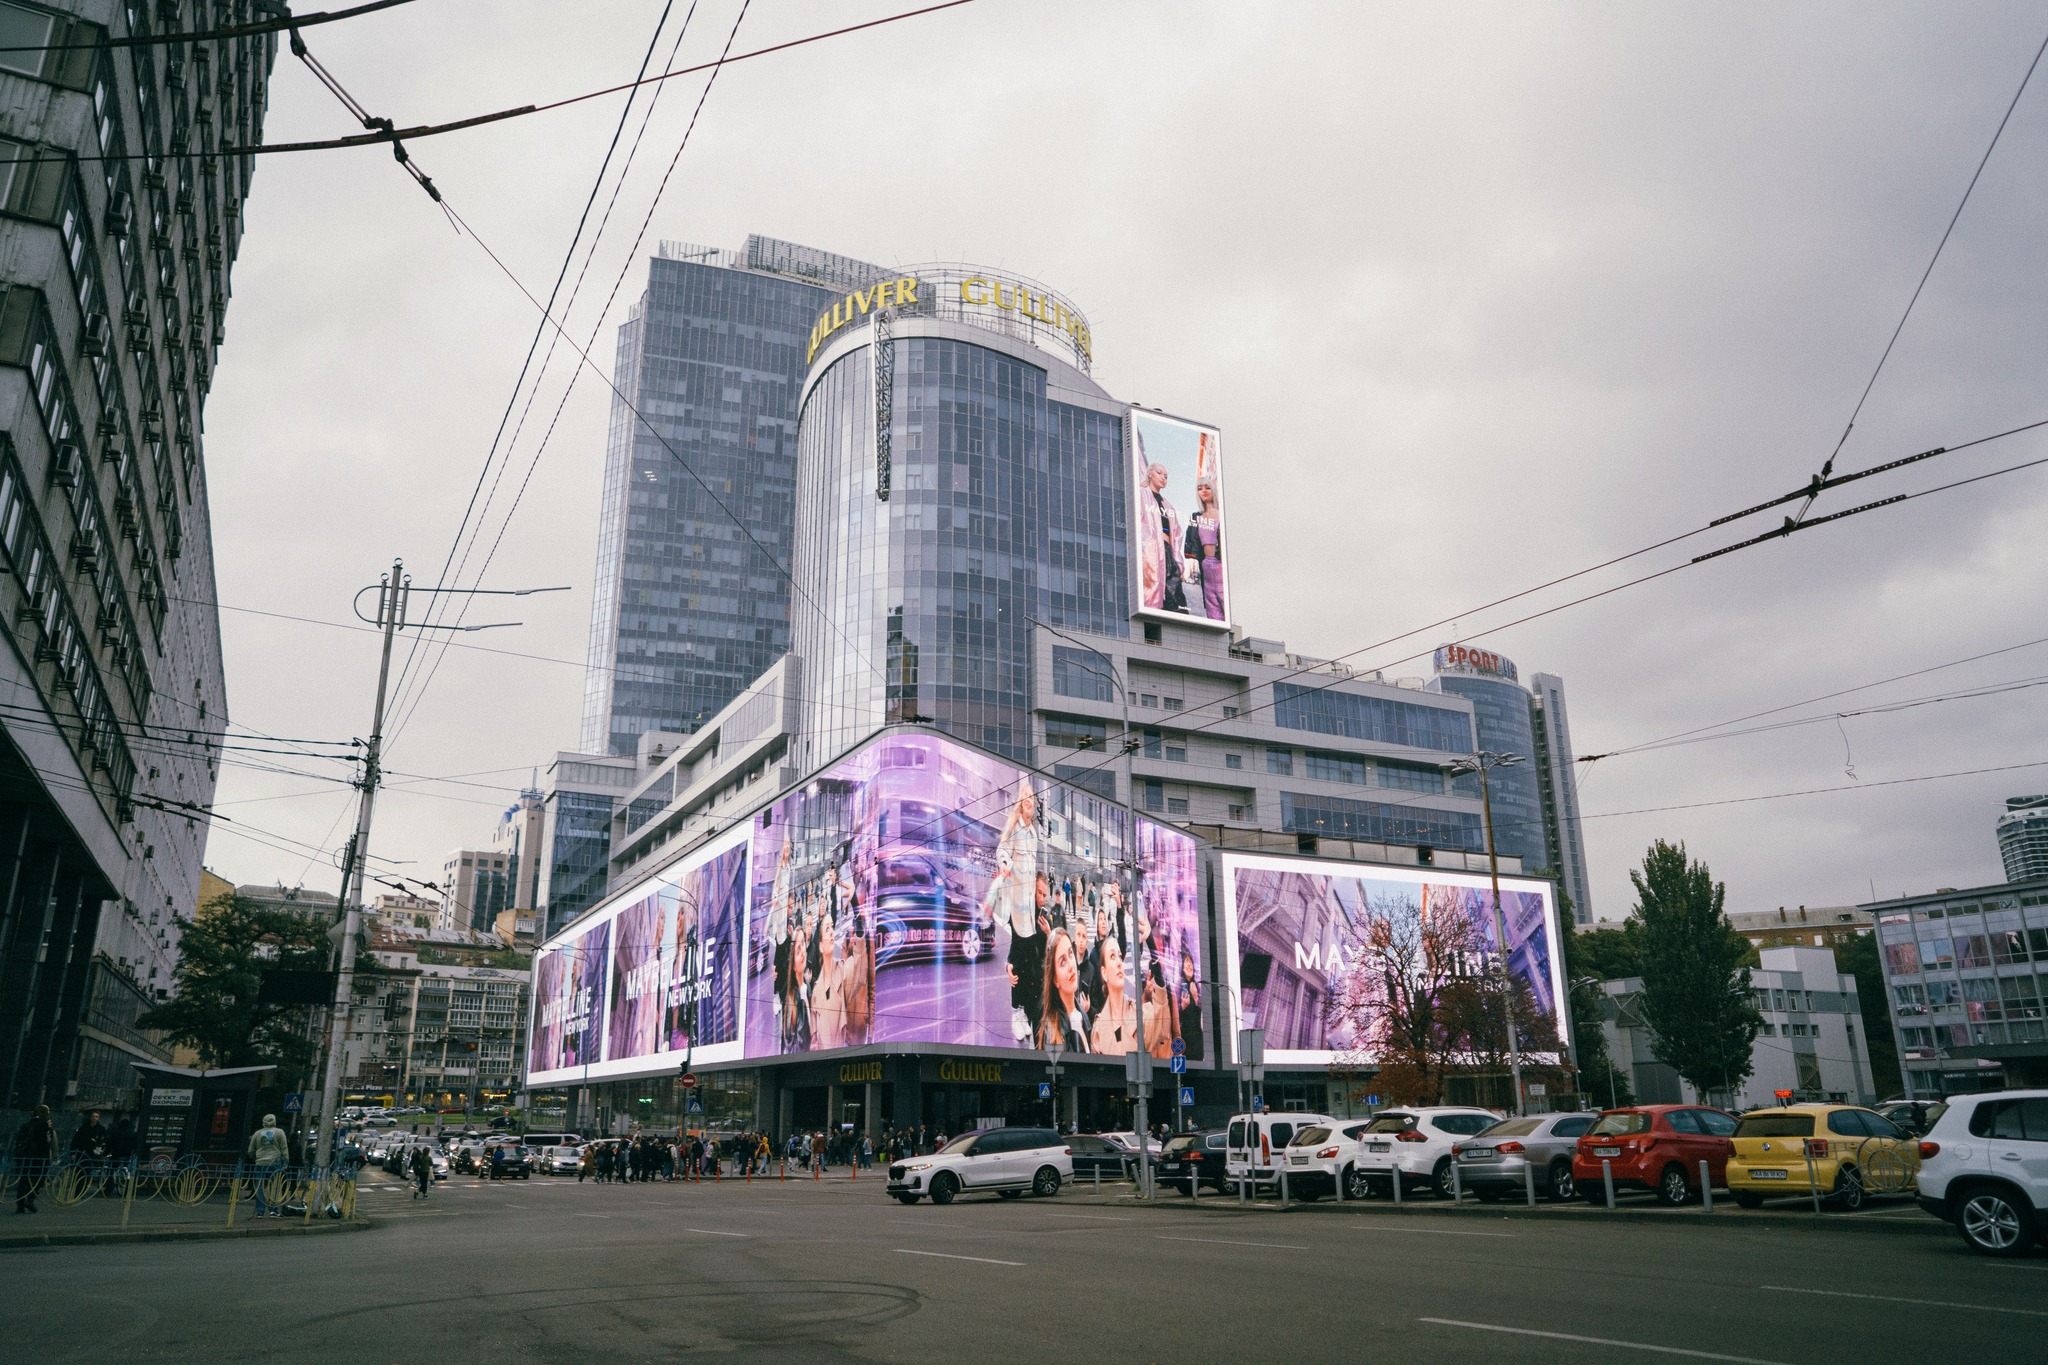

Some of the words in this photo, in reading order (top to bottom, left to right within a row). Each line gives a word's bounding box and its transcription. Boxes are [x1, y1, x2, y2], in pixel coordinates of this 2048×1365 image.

[807, 277, 919, 365] GULLIVER
[960, 277, 1093, 363] GULLIVER
[1198, 523, 1215, 532] YORK
[1448, 645, 1499, 673] SPORT
[626, 937, 717, 1001] MAYBELLINE
[667, 985, 688, 1008] NEW
[686, 978, 713, 1002] YORK
[839, 1061, 882, 1083] GULLIVER
[940, 1061, 1002, 1082] GULLIVER
